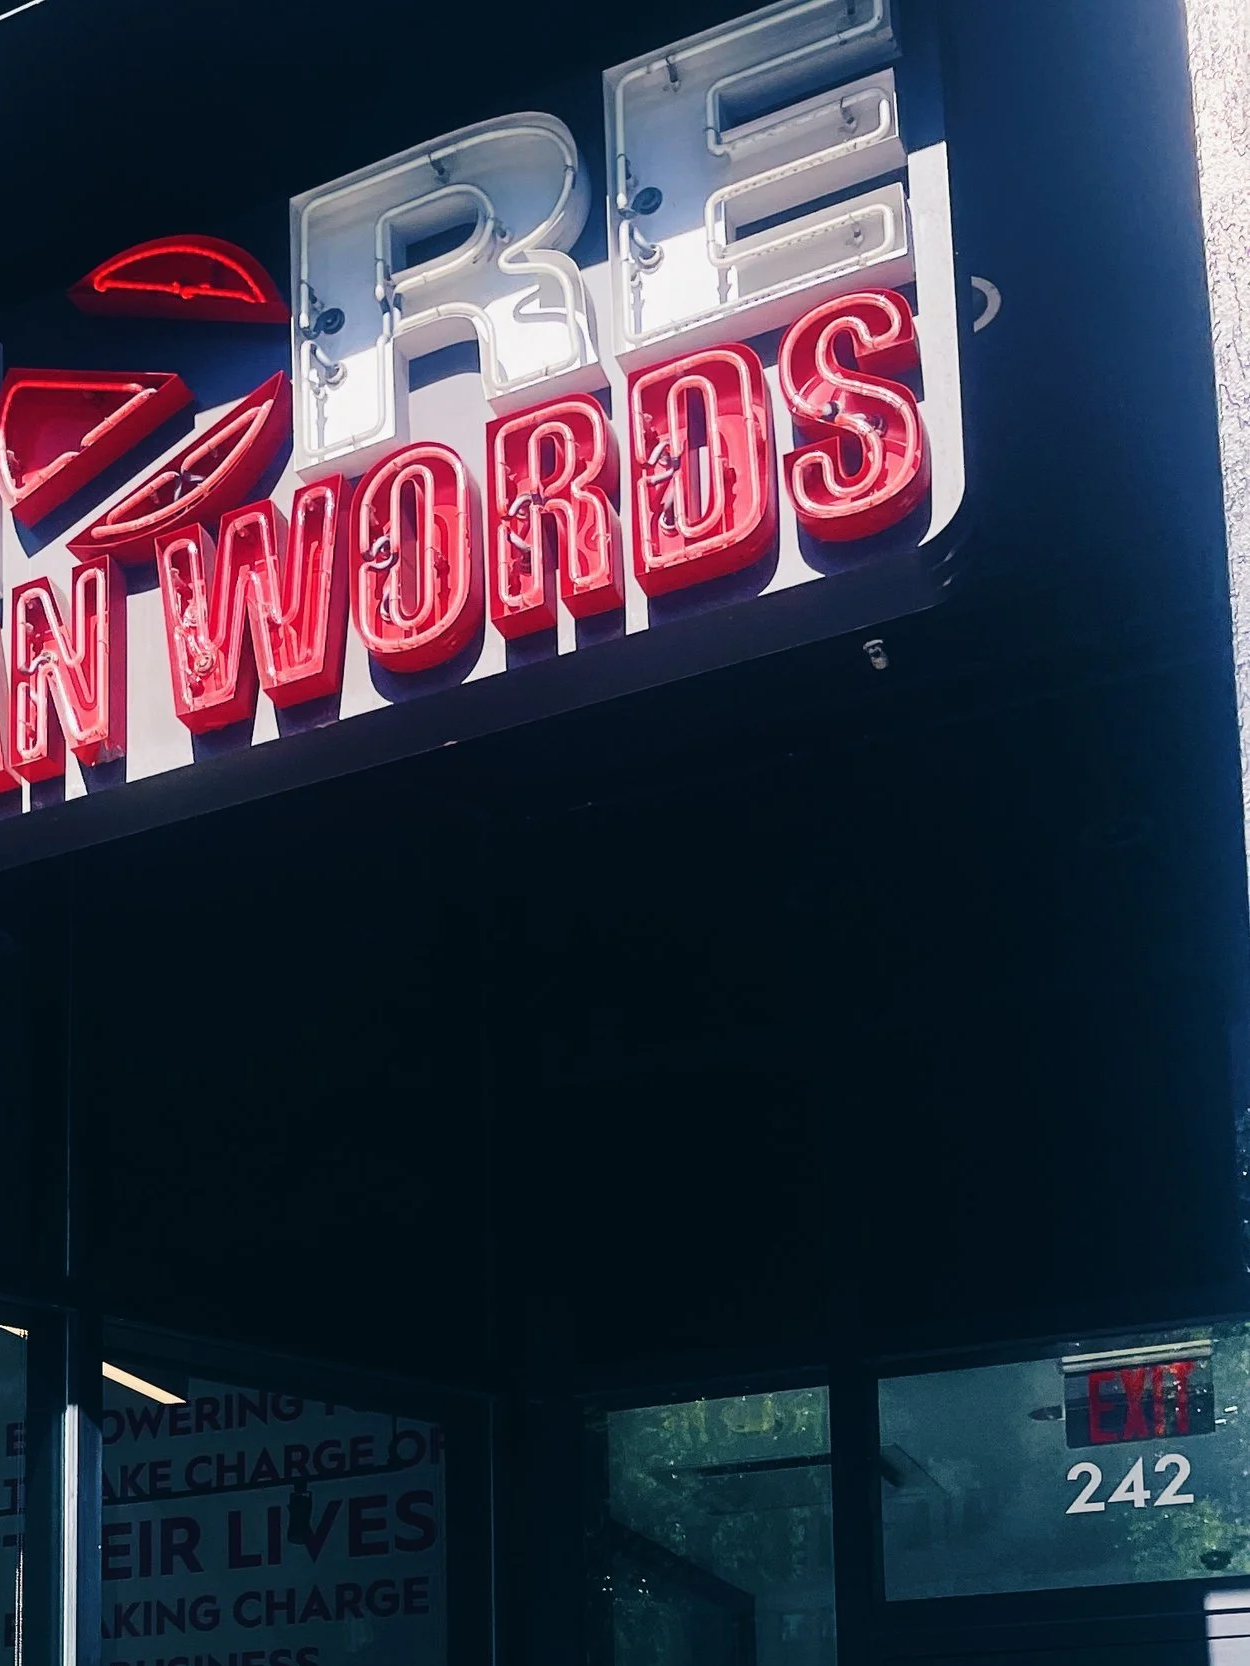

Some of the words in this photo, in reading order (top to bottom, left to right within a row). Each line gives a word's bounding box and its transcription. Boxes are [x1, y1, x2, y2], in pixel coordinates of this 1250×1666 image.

[155, 288, 932, 735] WORDS
[1087, 1361, 1196, 1444] EXIT
[185, 1434, 374, 1489] CHARGE
[1066, 1453, 1194, 1514] 242
[232, 1577, 430, 1628] CHARGE
